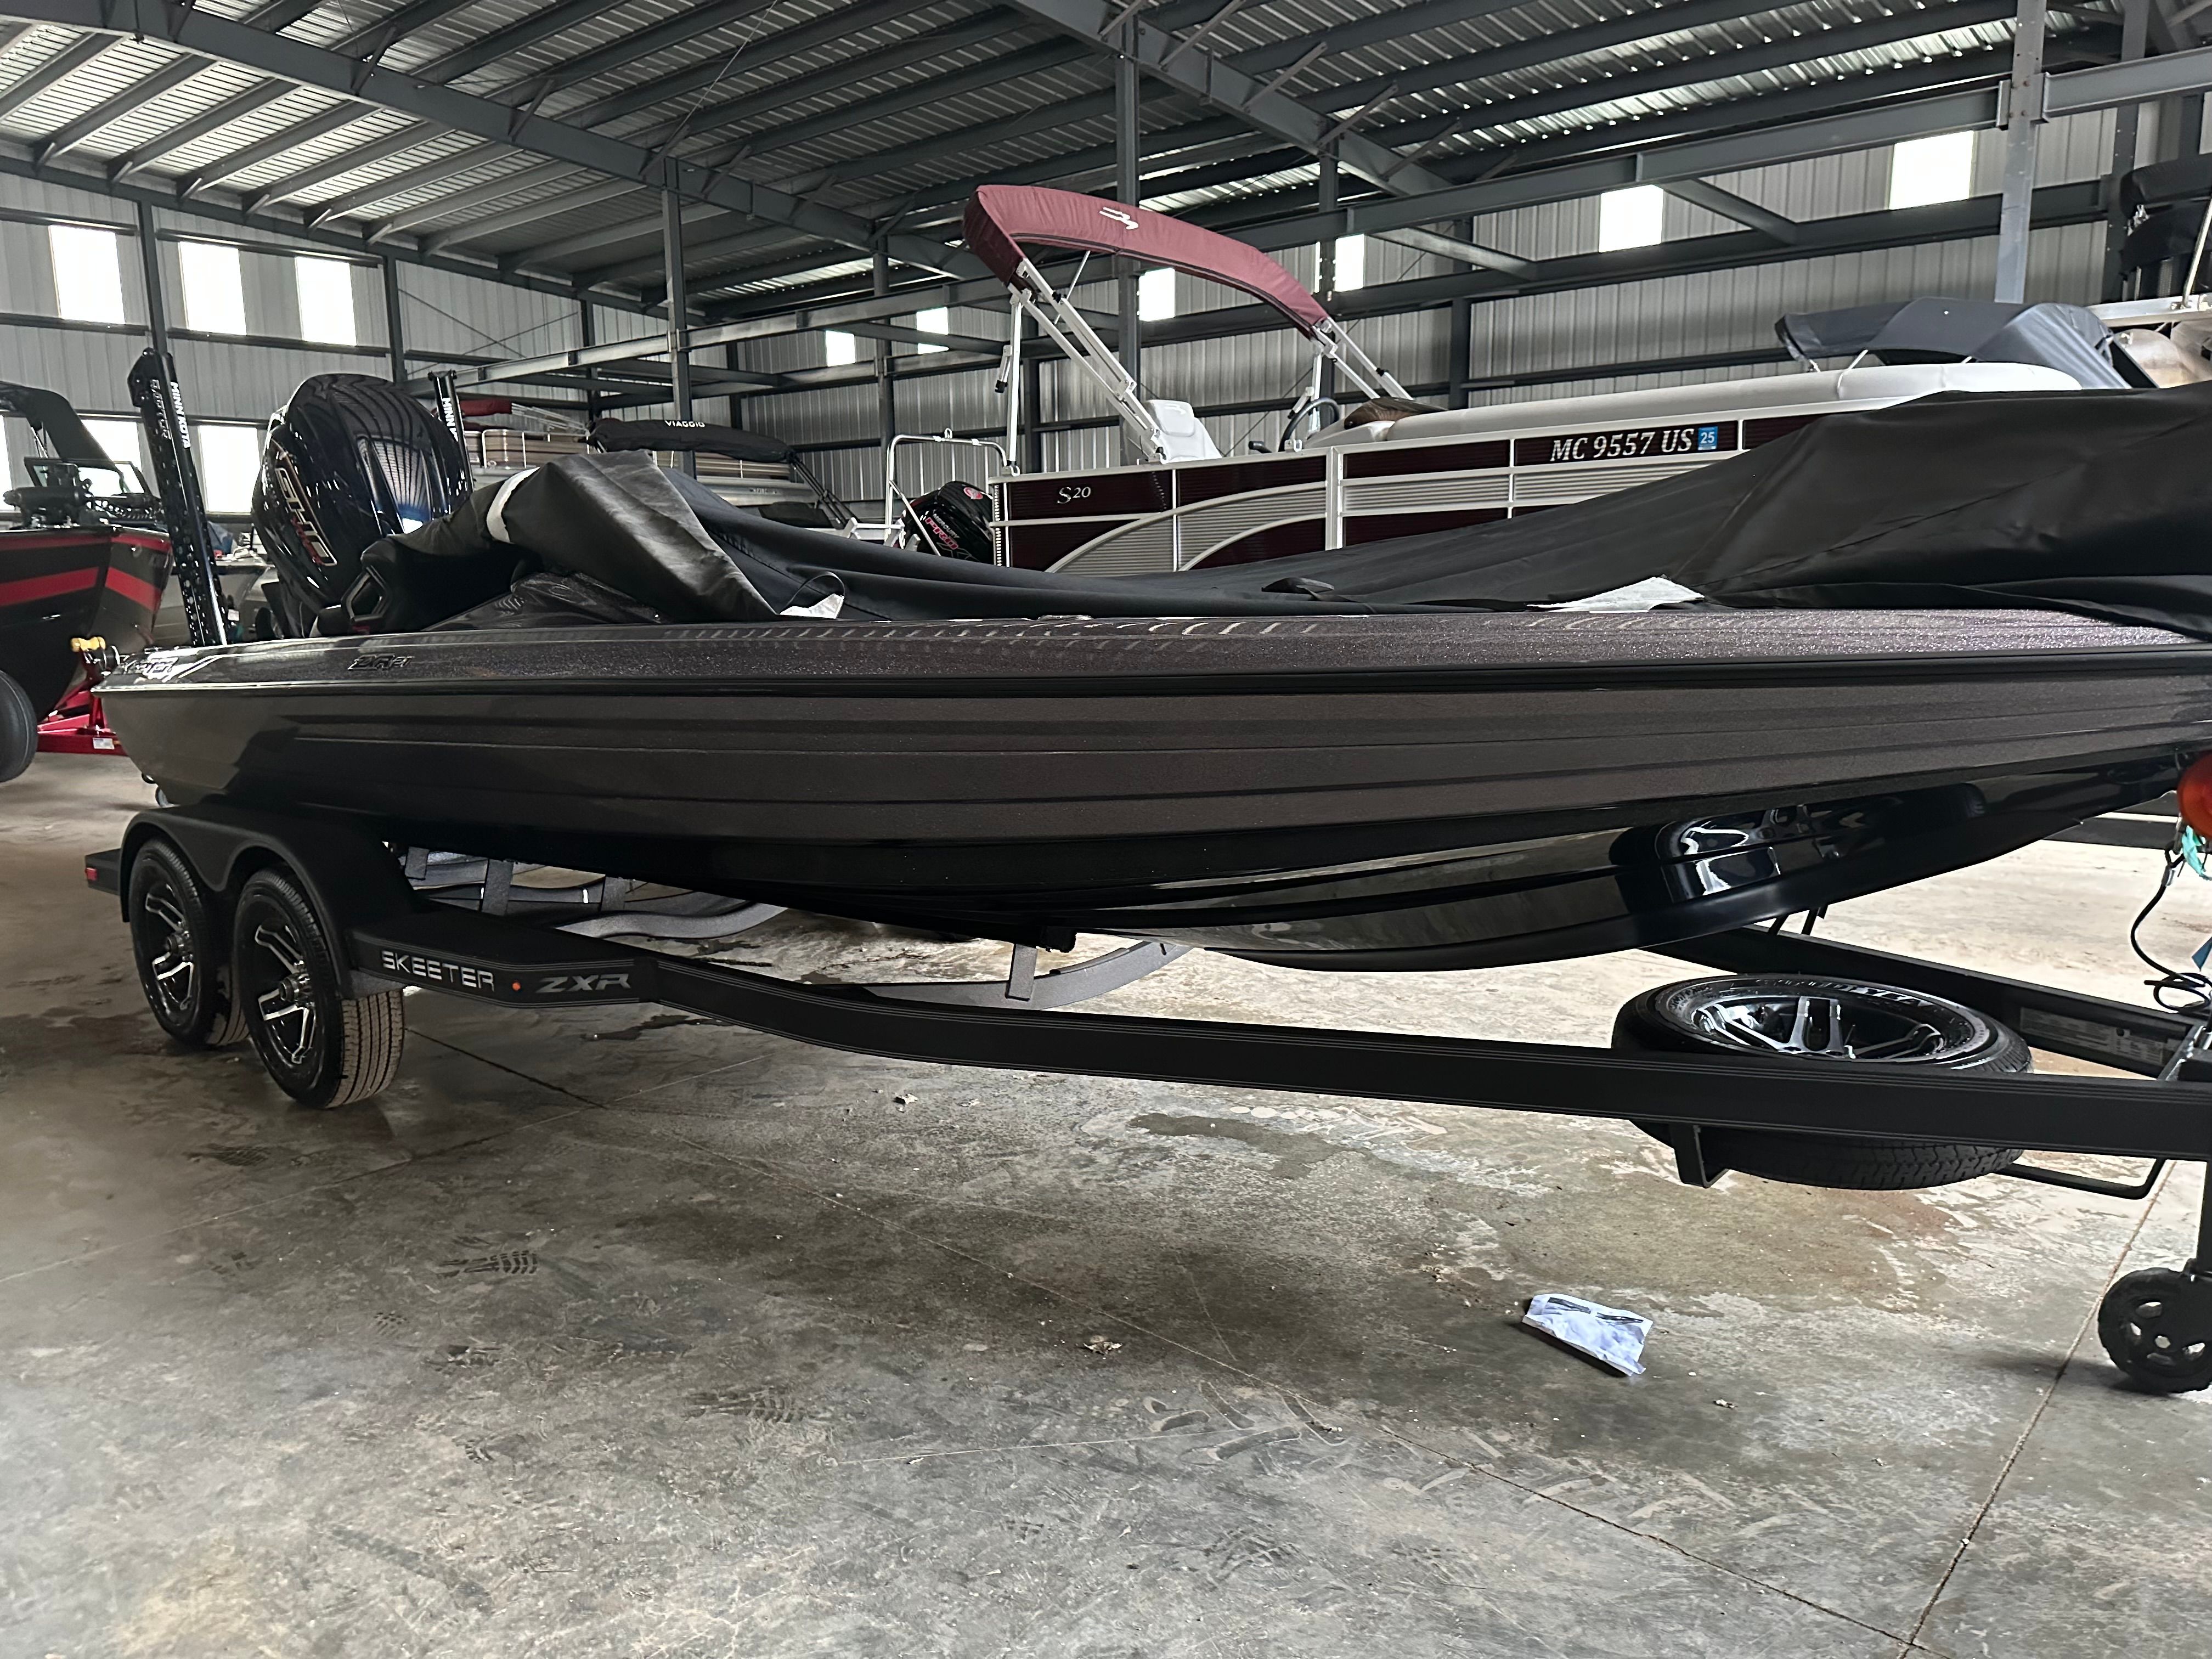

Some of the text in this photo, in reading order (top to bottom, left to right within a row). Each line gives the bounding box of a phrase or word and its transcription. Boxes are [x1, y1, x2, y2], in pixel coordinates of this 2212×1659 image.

[170, 381, 191, 449] MINN KOTA
[442, 397, 456, 427] MINN
[1550, 428, 1695, 462] MC 9557 US
[1700, 431, 1715, 444] 25
[1057, 486, 1091, 504] S20
[275, 467, 337, 567] SHO
[933, 513, 960, 539] MERCURY
[924, 517, 959, 550] PRO
[381, 950, 494, 992] SKEETER
[535, 973, 631, 994] ZXR
